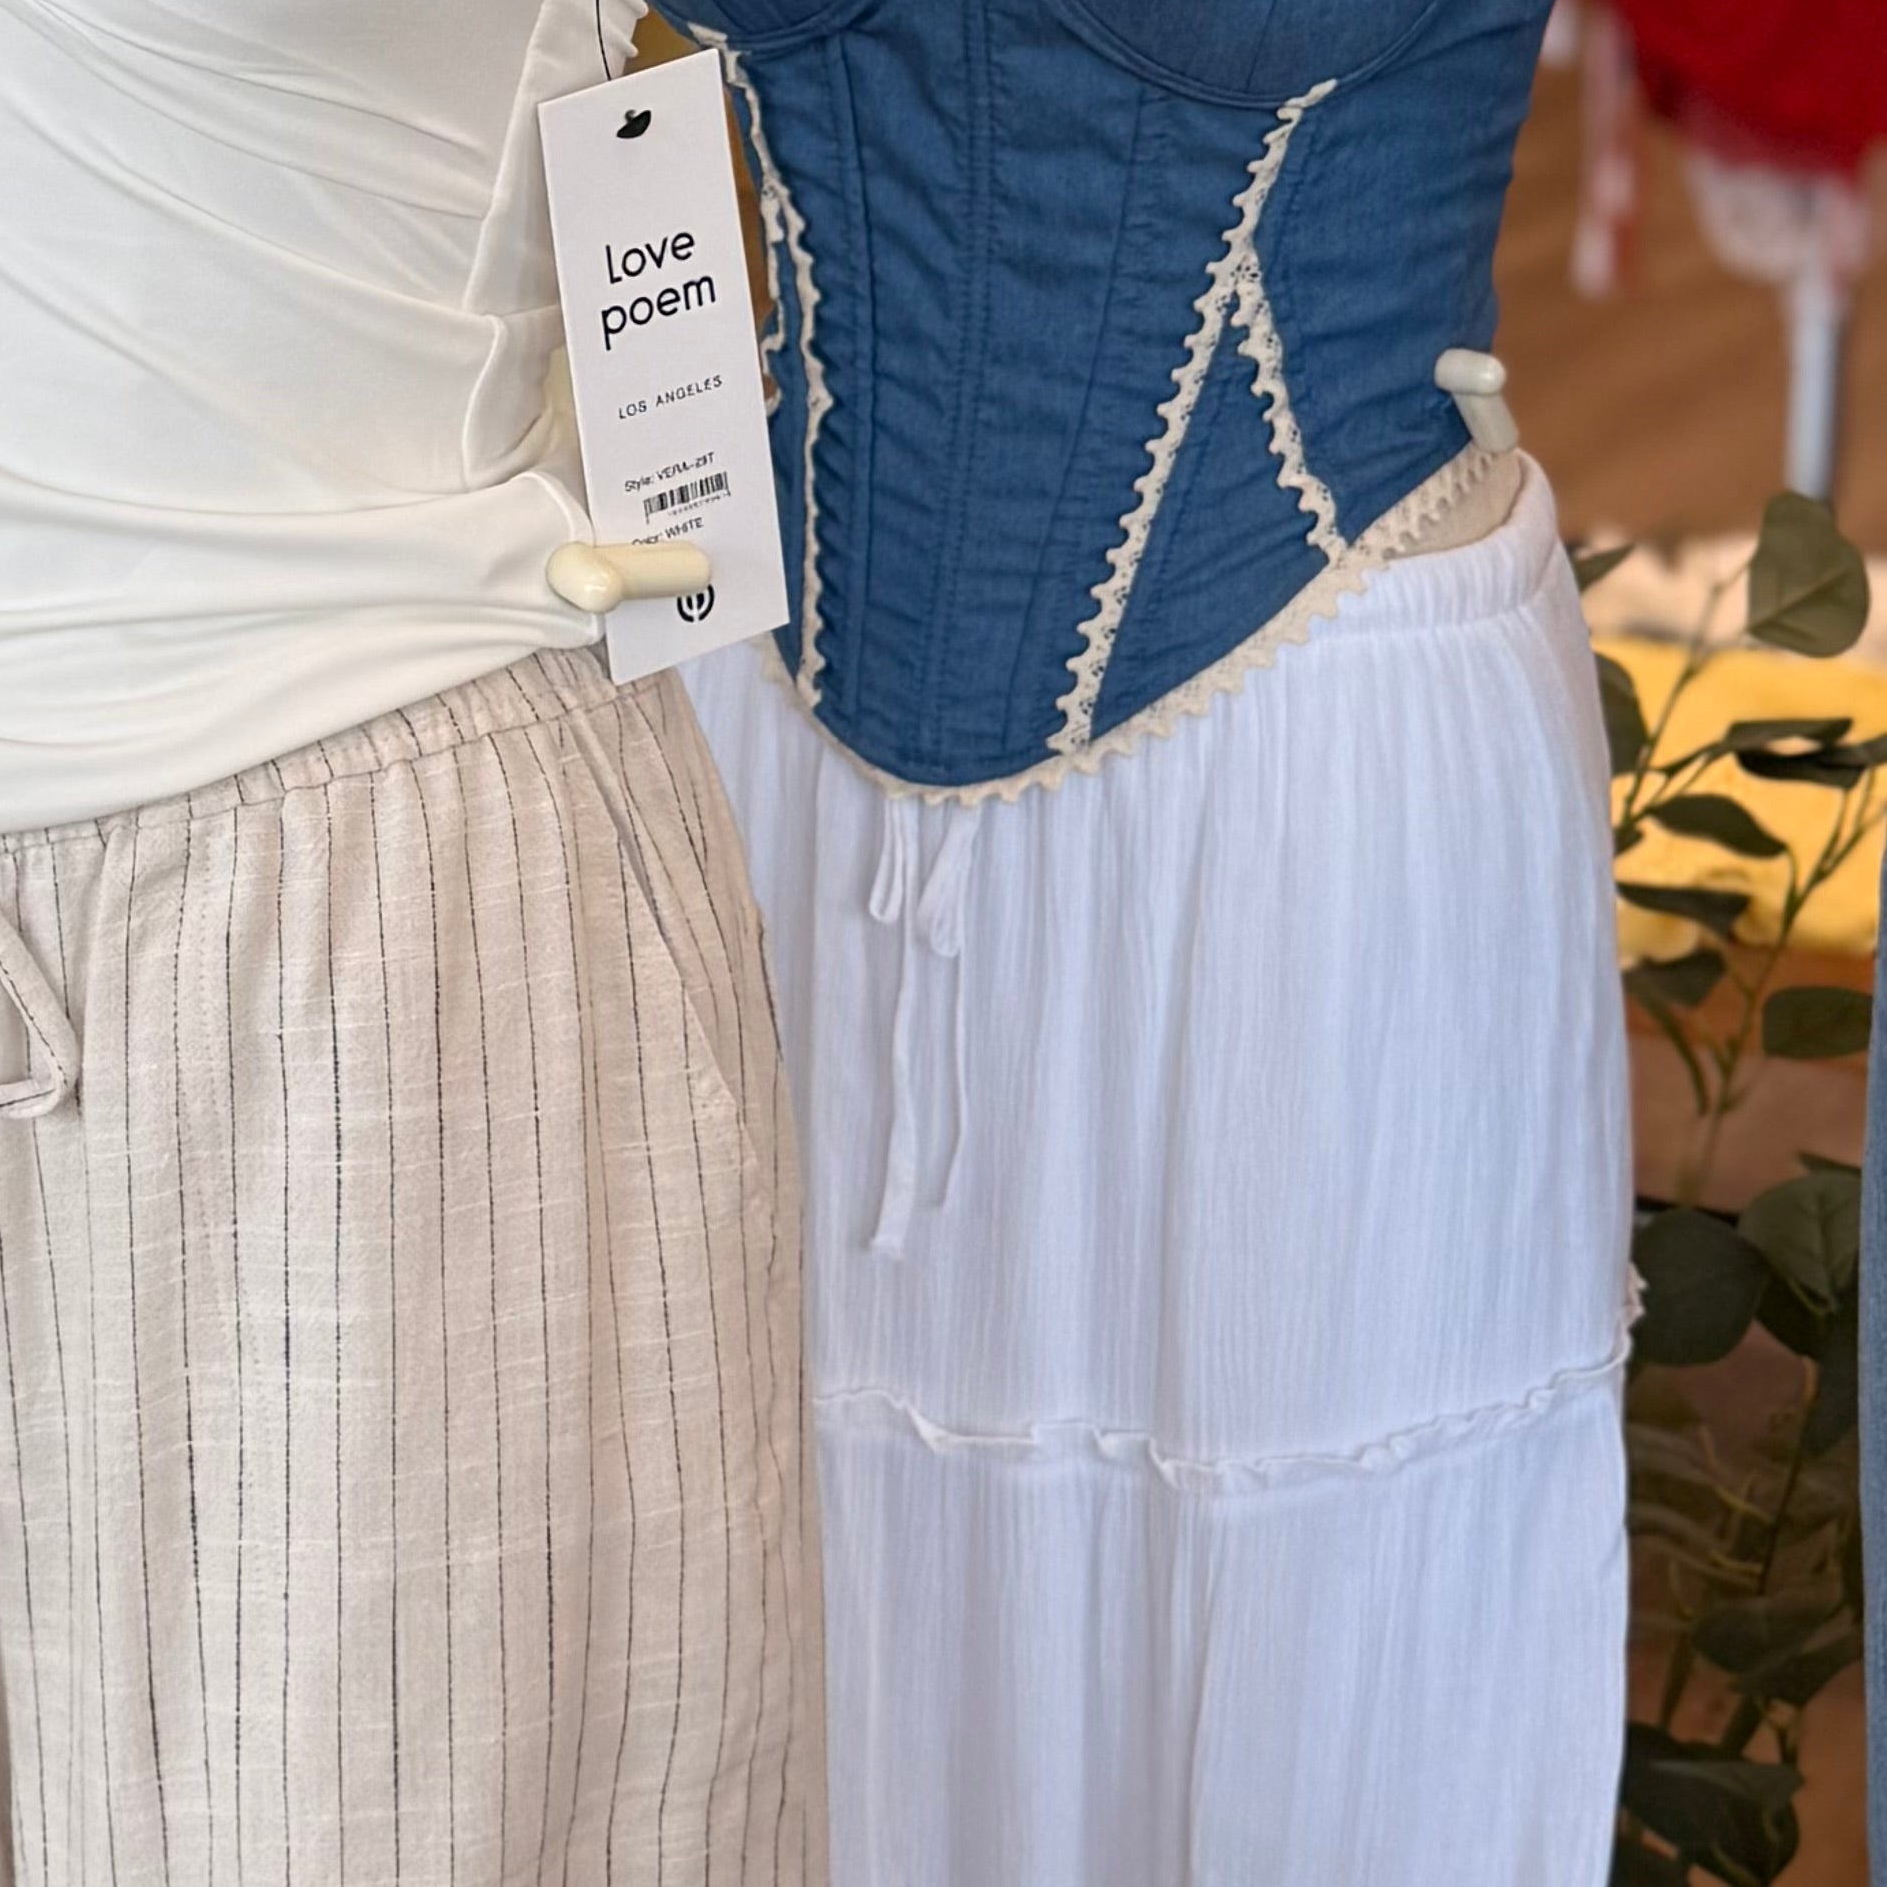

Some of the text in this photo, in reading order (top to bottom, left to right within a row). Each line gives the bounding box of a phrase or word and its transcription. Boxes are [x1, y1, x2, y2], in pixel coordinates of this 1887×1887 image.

[601, 275, 716, 351] poem
[618, 374, 723, 420] LOS ANGELES
[665, 517, 704, 539] WHITE
